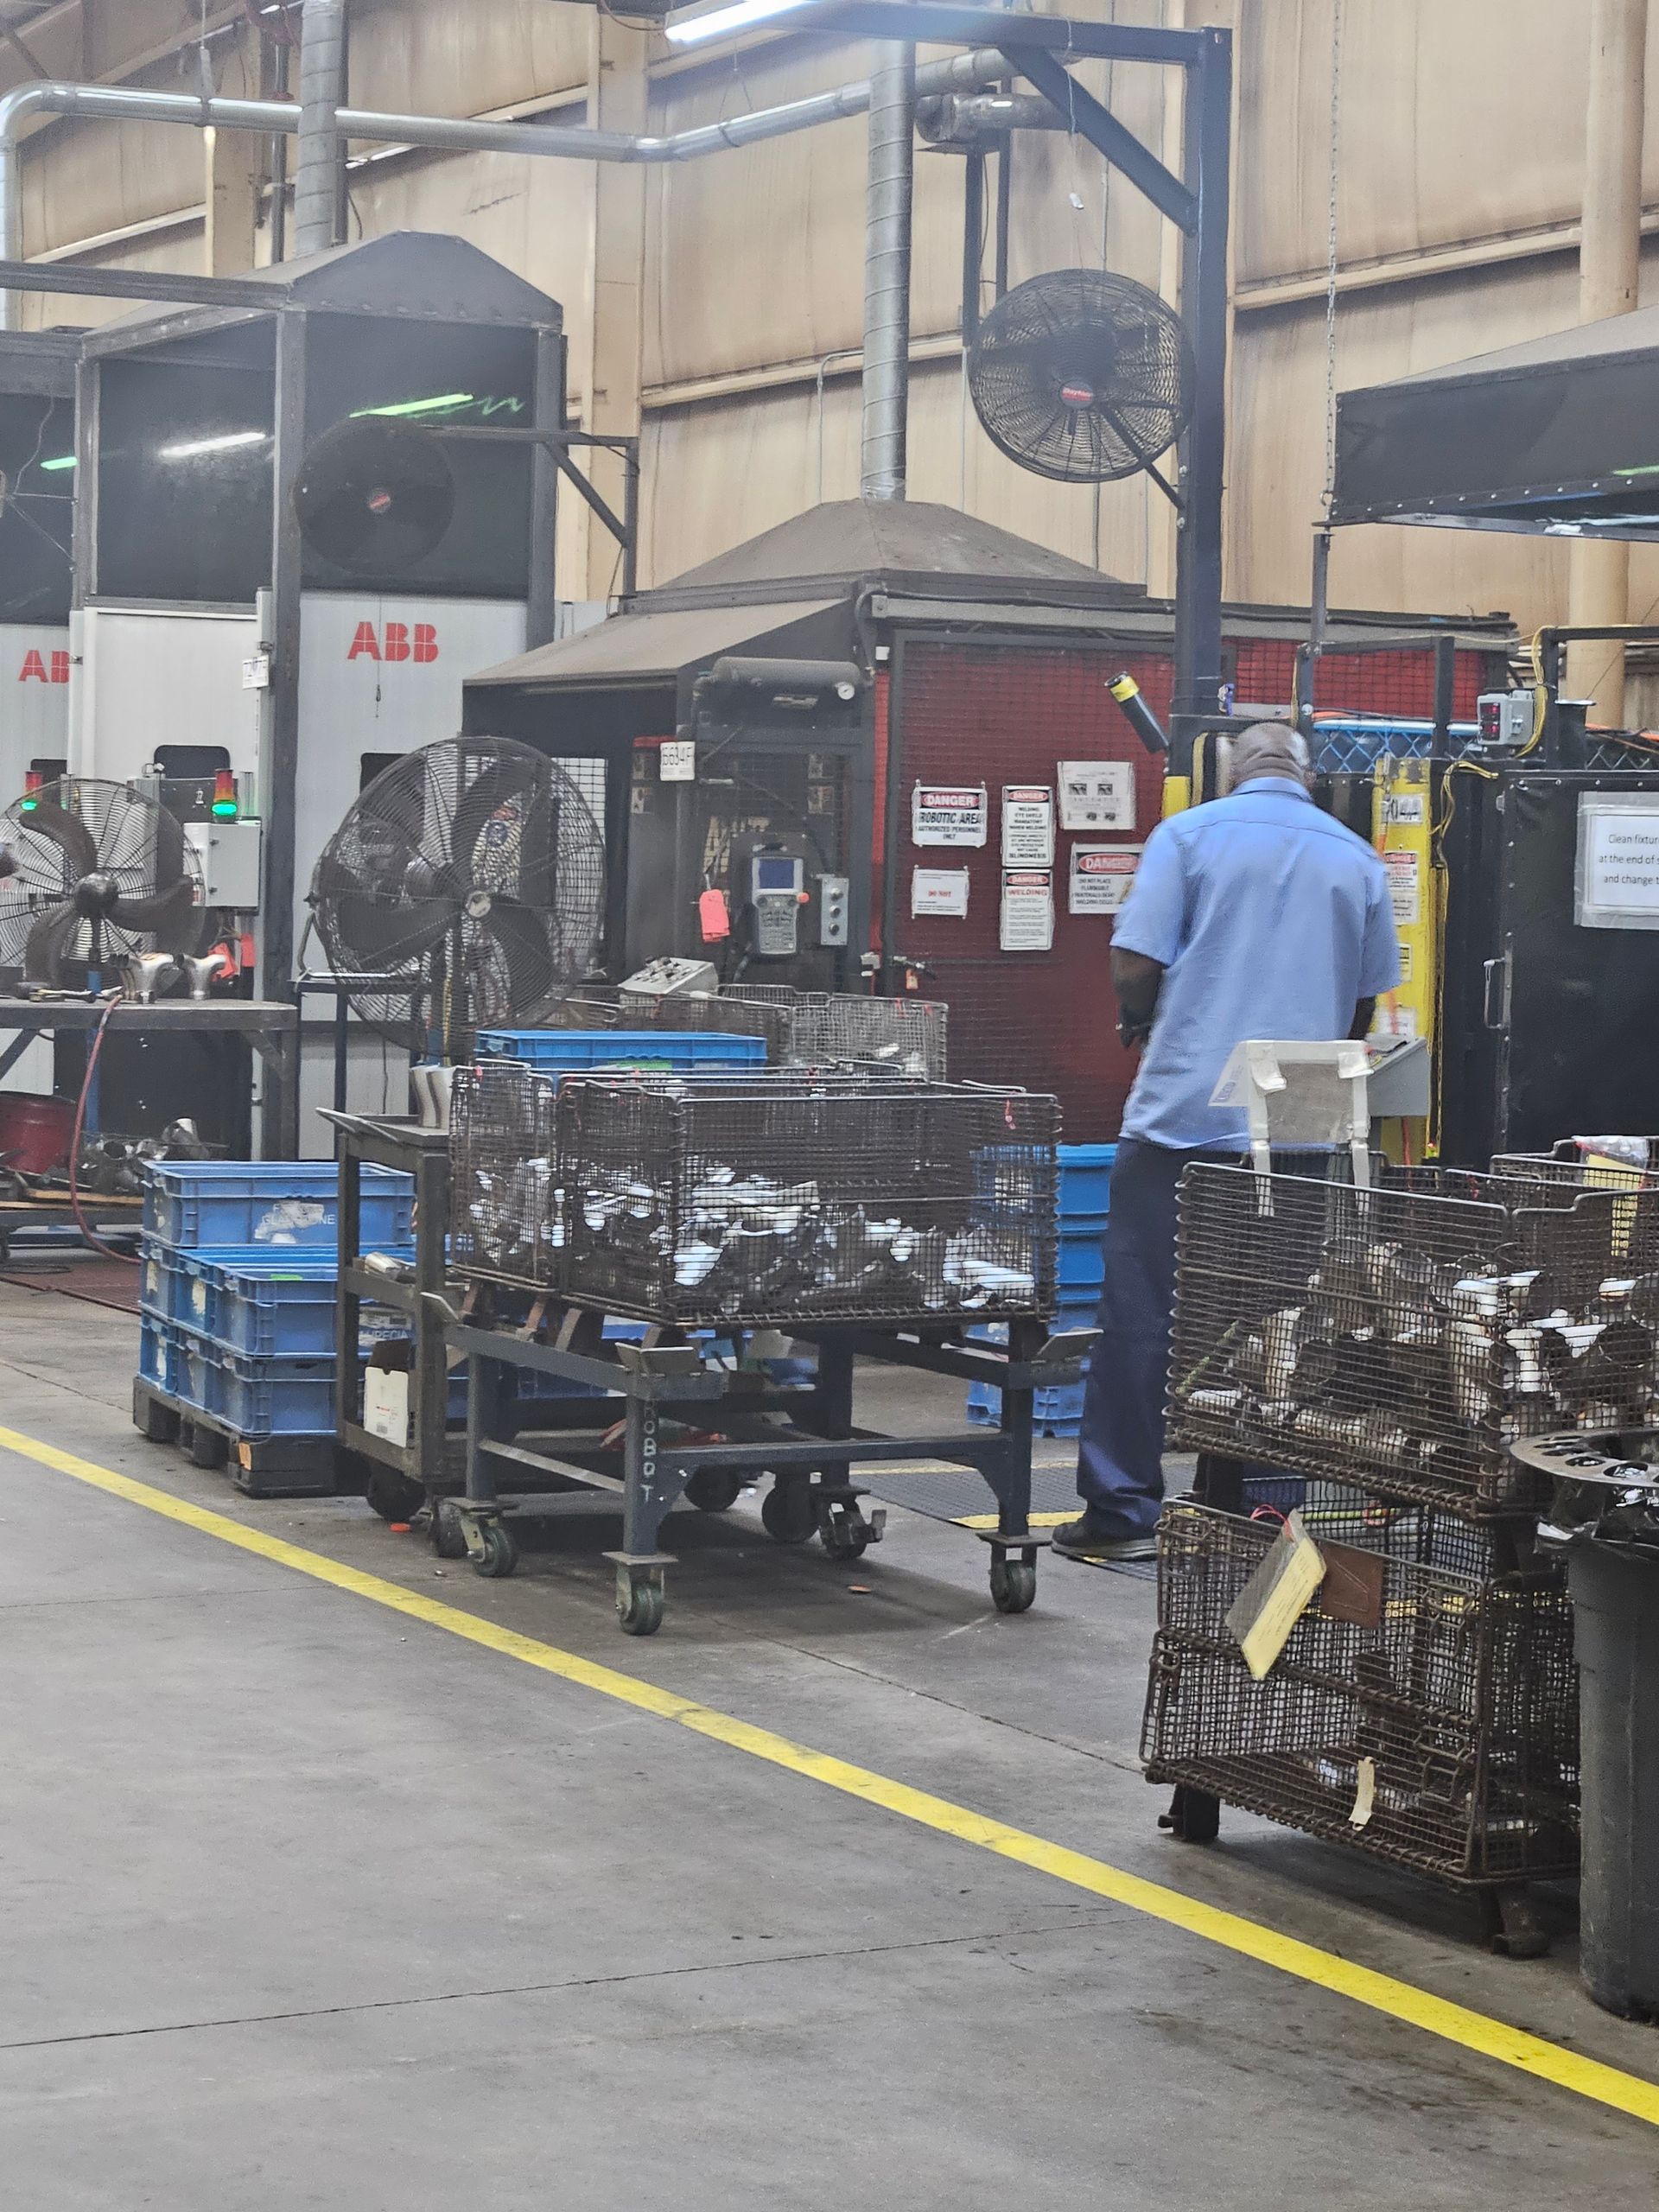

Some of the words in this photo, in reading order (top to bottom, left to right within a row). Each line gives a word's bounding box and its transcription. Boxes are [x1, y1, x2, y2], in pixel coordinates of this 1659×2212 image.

[347, 621, 439, 663] ABB
[18, 649, 70, 683] AB
[926, 794, 974, 807] DANGER
[919, 812, 957, 823] ROBOTIC
[959, 812, 982, 824] AREA
[1609, 834, 1632, 844] Clean
[1634, 834, 1659, 845] fixtur
[1609, 854, 1624, 864] the
[1626, 855, 1643, 865] end
[1645, 854, 1656, 865] of
[1604, 874, 1619, 884] and
[1621, 874, 1654, 887] change
